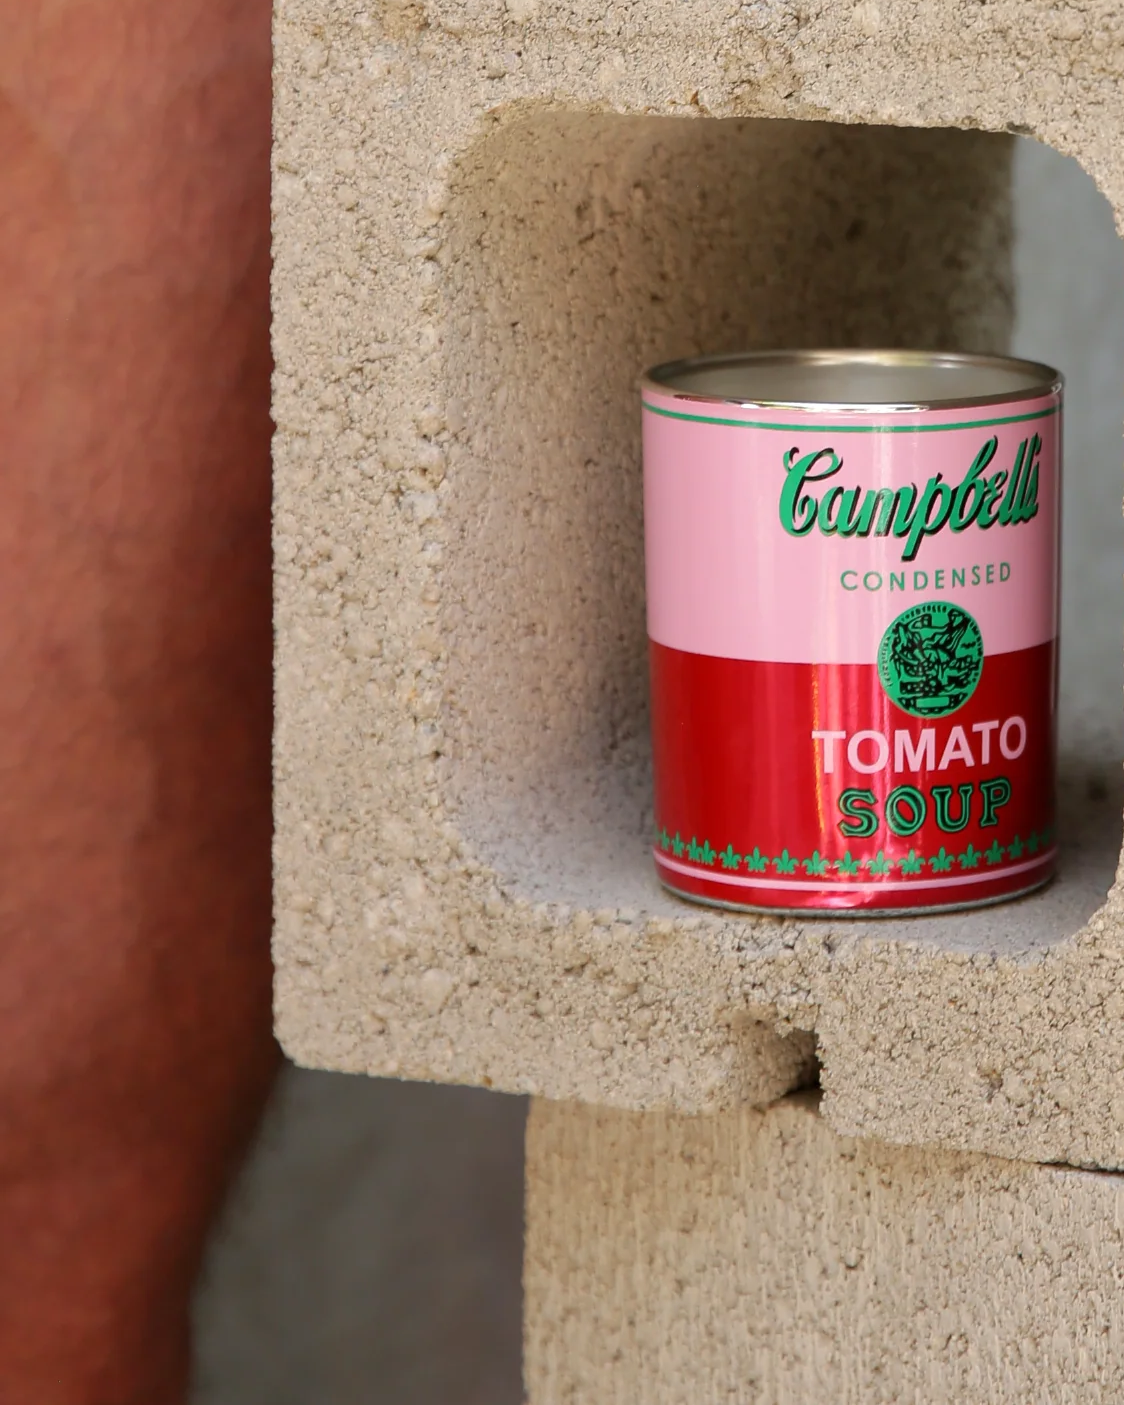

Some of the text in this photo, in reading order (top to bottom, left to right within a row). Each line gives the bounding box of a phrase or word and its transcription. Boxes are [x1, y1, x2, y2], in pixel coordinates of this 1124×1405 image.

[840, 563, 1011, 592] CONDENSED
[811, 715, 1027, 775] TOMATO
[838, 777, 1011, 838] SOUP
